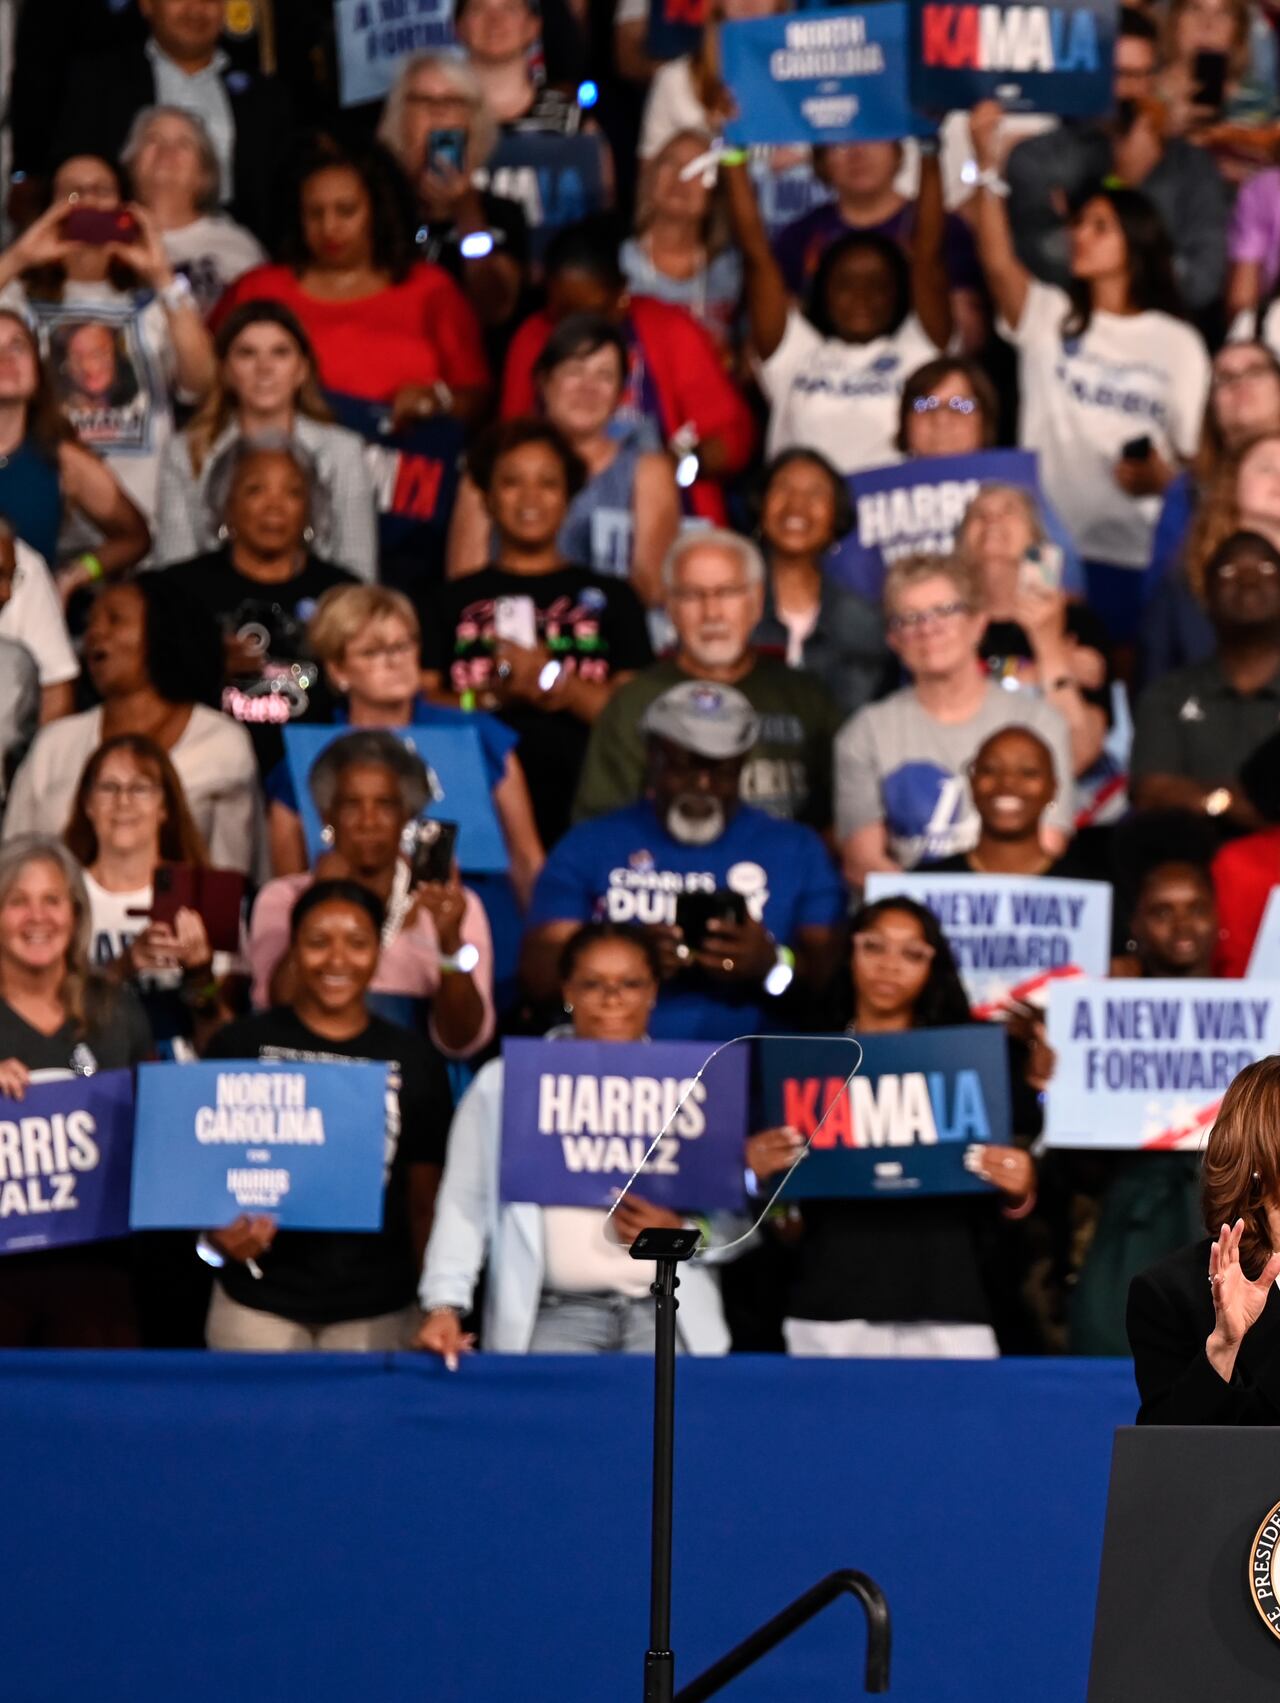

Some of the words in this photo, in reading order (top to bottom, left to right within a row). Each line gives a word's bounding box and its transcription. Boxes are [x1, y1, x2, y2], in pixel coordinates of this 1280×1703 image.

[923, 4, 1100, 72] KAMALA
[1010, 893, 1086, 928] WAY
[1071, 999, 1094, 1041] A
[1105, 999, 1182, 1041] NEW
[1194, 999, 1271, 1041] WAY
[216, 1073, 307, 1108] NORTH
[538, 1073, 709, 1140] HARRIS
[783, 1069, 992, 1149] KAMALA
[194, 1106, 326, 1146] CAROLINA
[561, 1136, 681, 1175] WALZ
